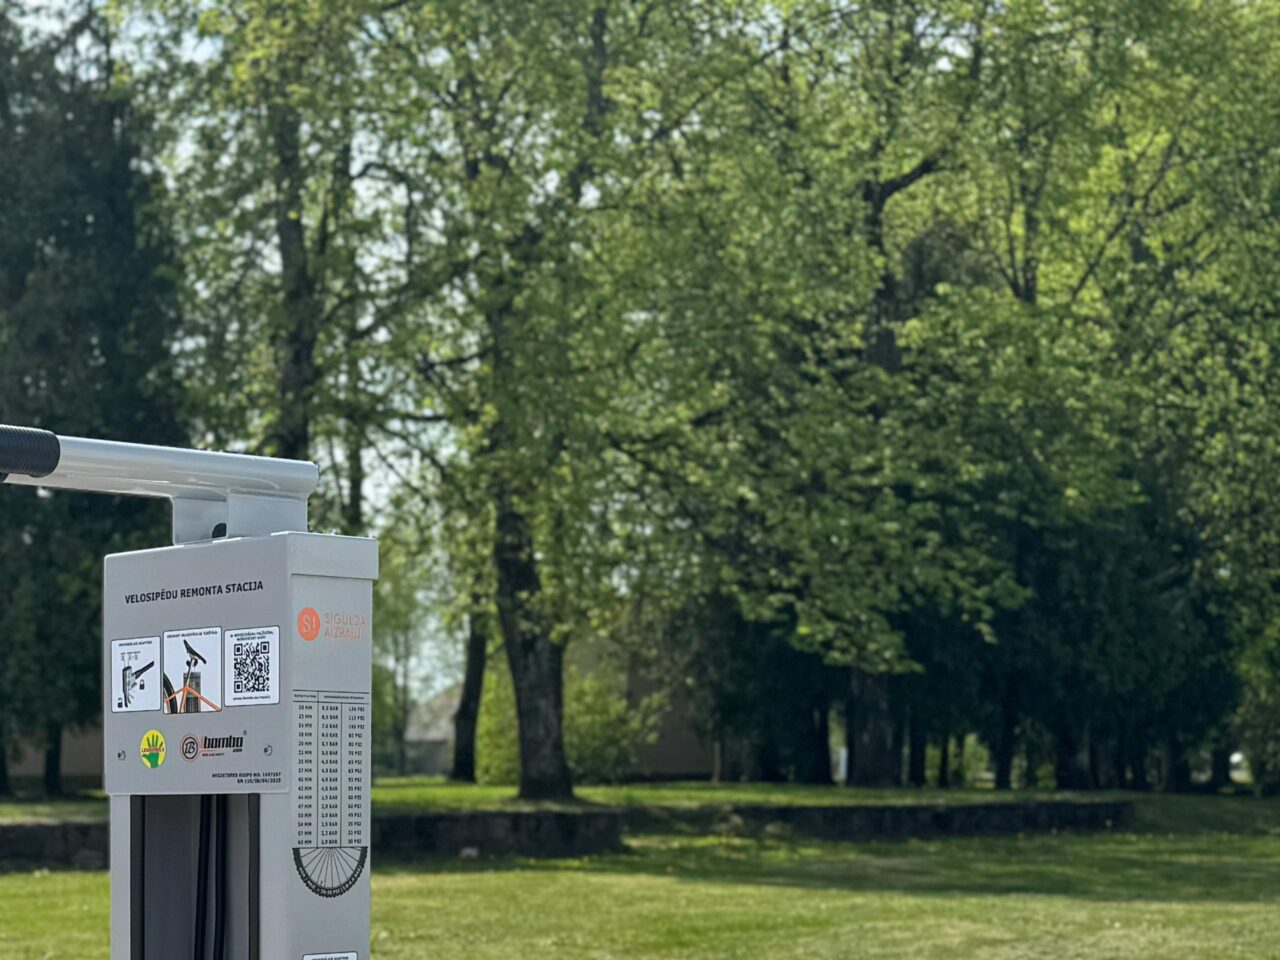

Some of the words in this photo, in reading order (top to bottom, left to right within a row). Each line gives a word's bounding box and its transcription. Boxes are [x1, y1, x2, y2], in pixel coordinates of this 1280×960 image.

[125, 588, 178, 604] VELOSIPĒDU
[180, 584, 223, 598] REMONTA
[225, 580, 264, 594] STACIJA
[324, 612, 368, 626] SIGULDA
